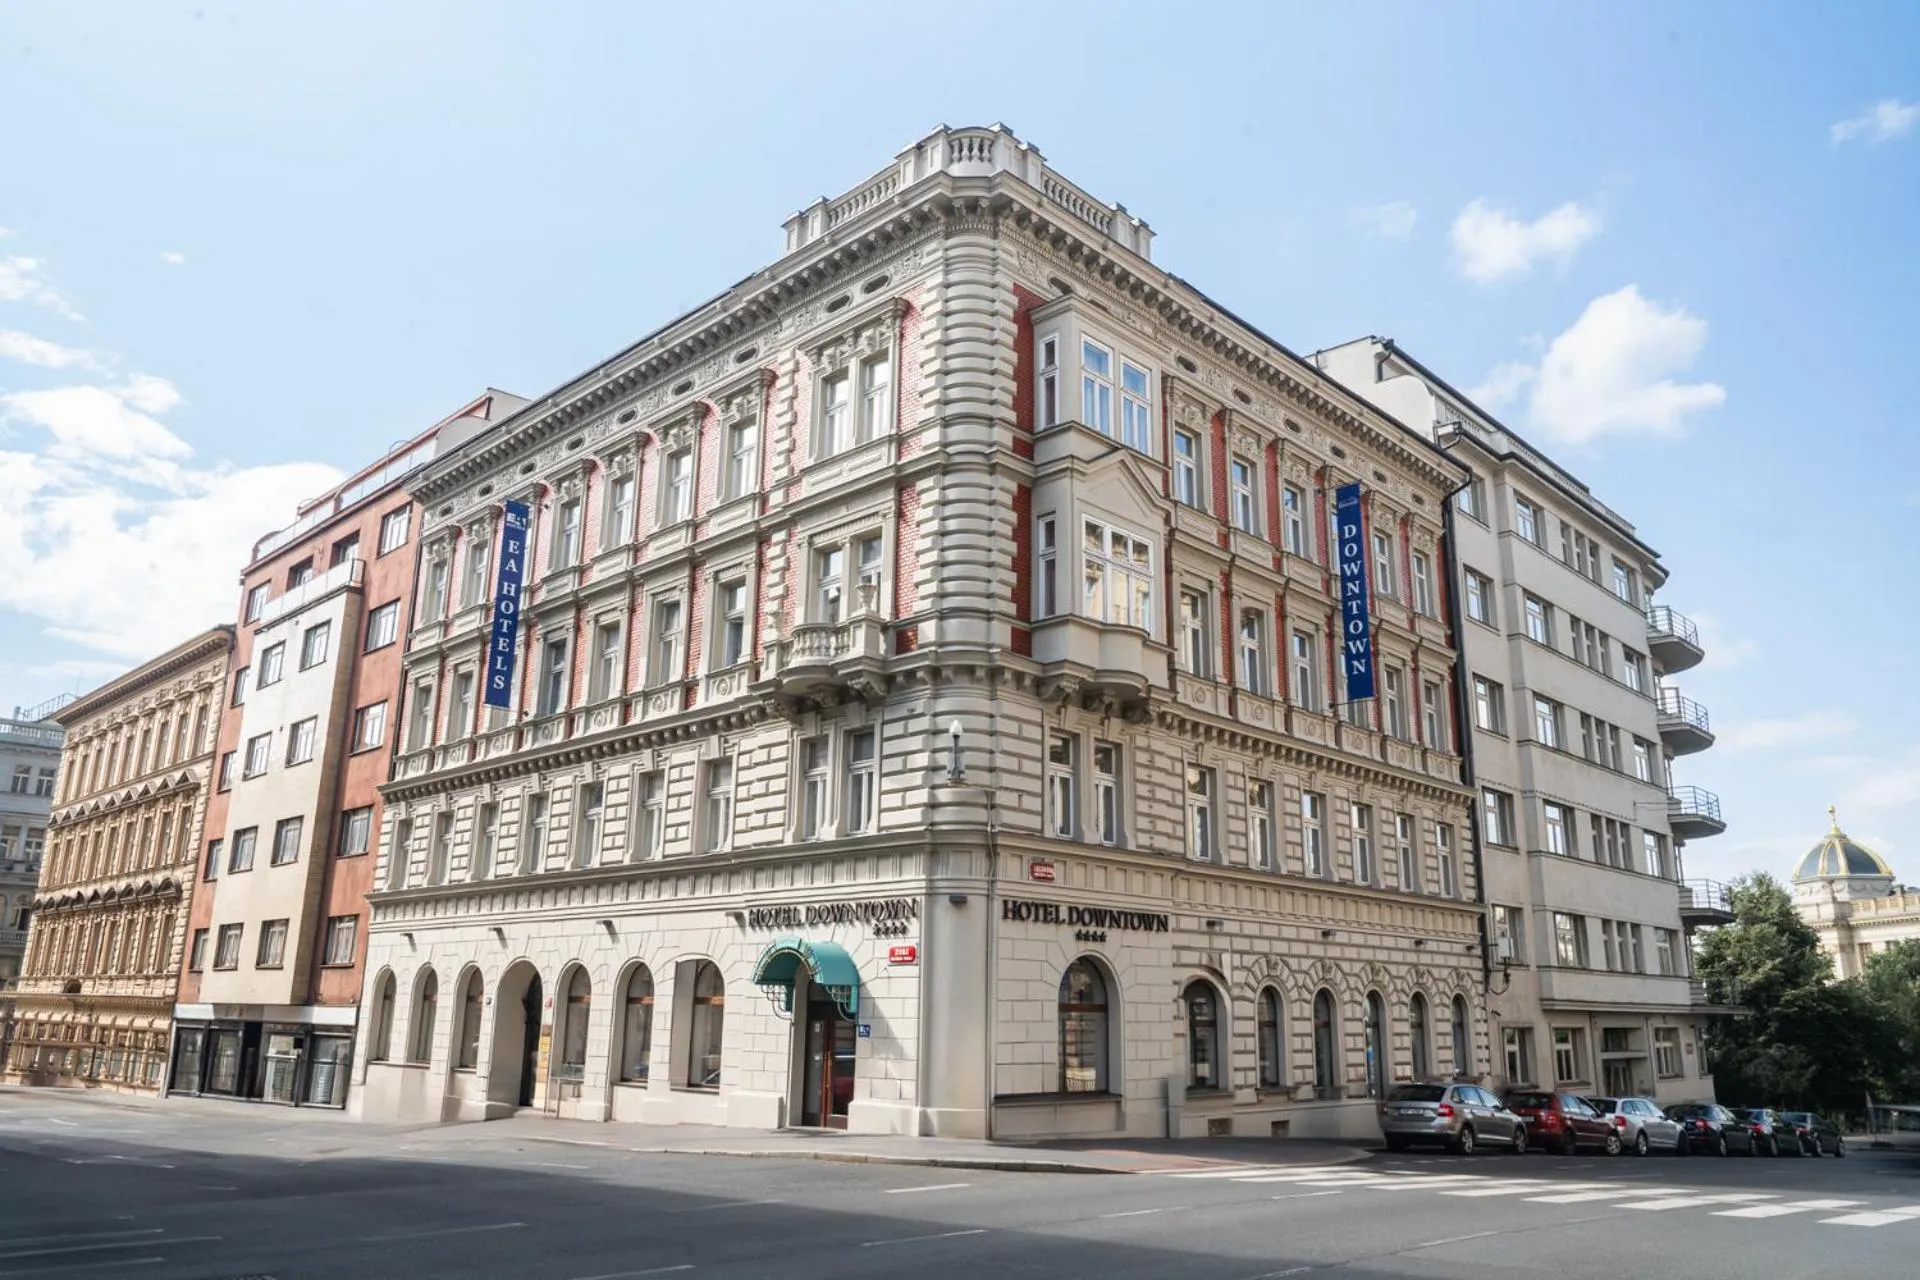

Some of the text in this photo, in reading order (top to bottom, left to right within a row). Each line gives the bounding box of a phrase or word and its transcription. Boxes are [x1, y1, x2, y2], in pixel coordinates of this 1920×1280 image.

[504, 540, 520, 573] EA
[1342, 524, 1368, 675] DOWNTOWN
[493, 581, 517, 690] HOTELS
[750, 898, 917, 929] HOTEL DOWNTOWN
[1002, 899, 1169, 932] HOTEL DOWNTOWN
